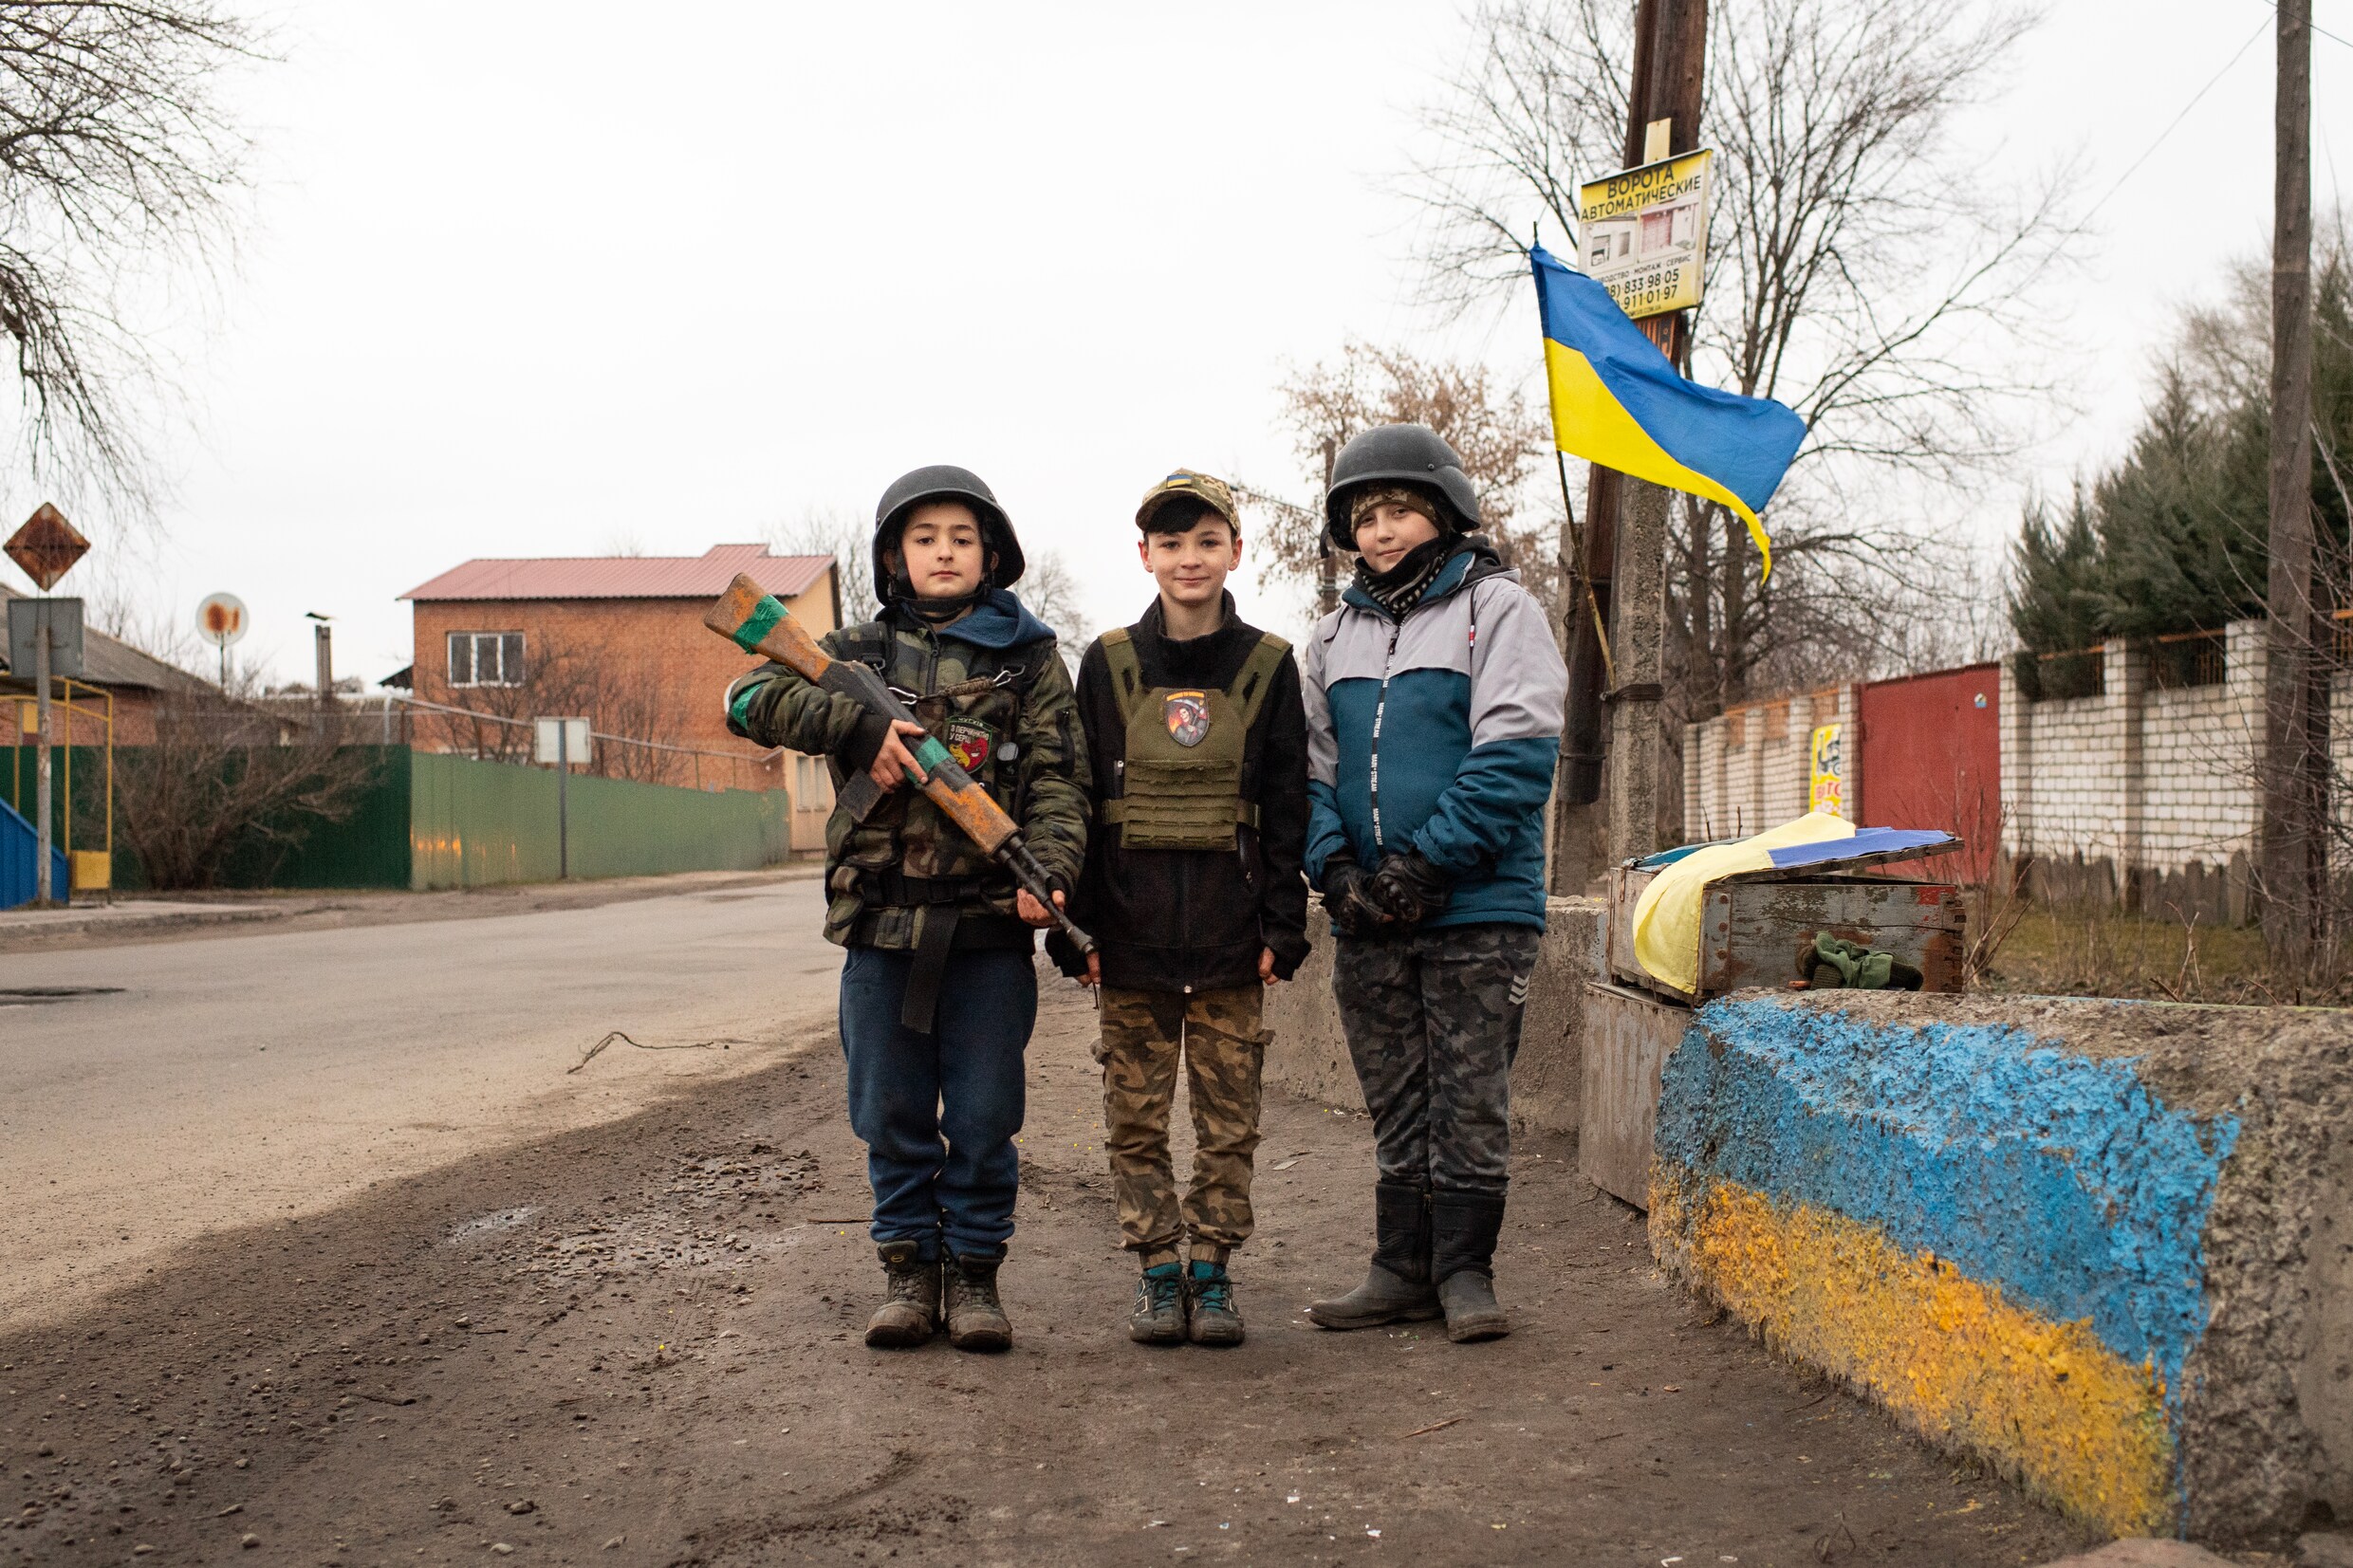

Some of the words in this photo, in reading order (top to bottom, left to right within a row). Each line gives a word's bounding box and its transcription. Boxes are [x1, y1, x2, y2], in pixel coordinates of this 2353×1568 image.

[1581, 175, 1701, 222] АВТОМАТИЧЕСКИЕ
[1607, 164, 1675, 199] ВОРОТА
[1634, 262, 1661, 274] МОНТАЖ
[1666, 254, 1692, 267] СЕРВИС
